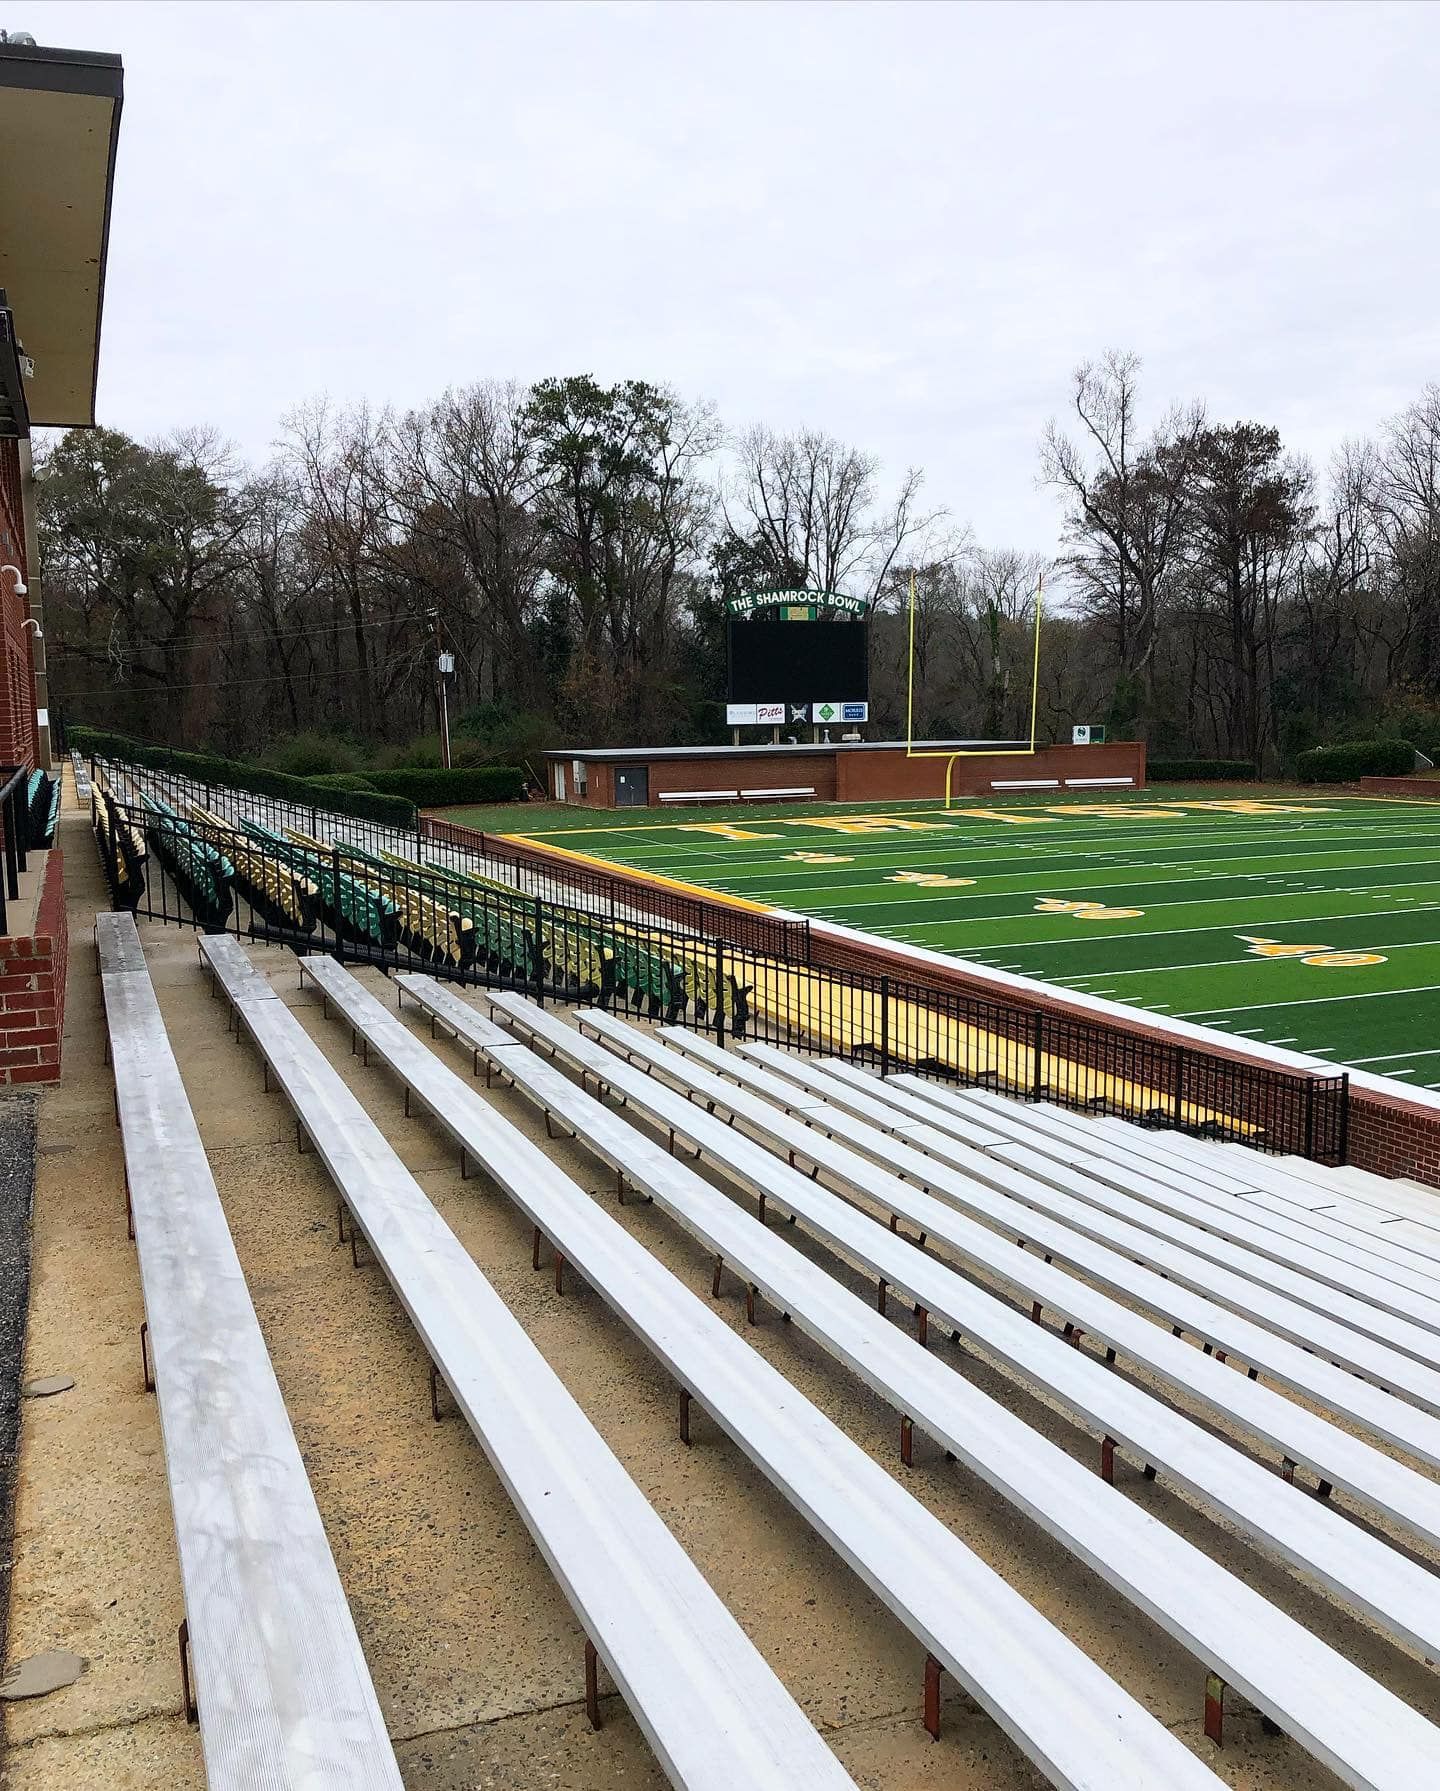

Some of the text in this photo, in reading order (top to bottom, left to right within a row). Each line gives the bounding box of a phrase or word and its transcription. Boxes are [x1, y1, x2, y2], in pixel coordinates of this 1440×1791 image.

[731, 590, 860, 612] THE SHAMROCK BOWL
[758, 707, 783, 720] Pitts
[1033, 901, 1145, 920] 30
[1239, 944, 1389, 967] 40
